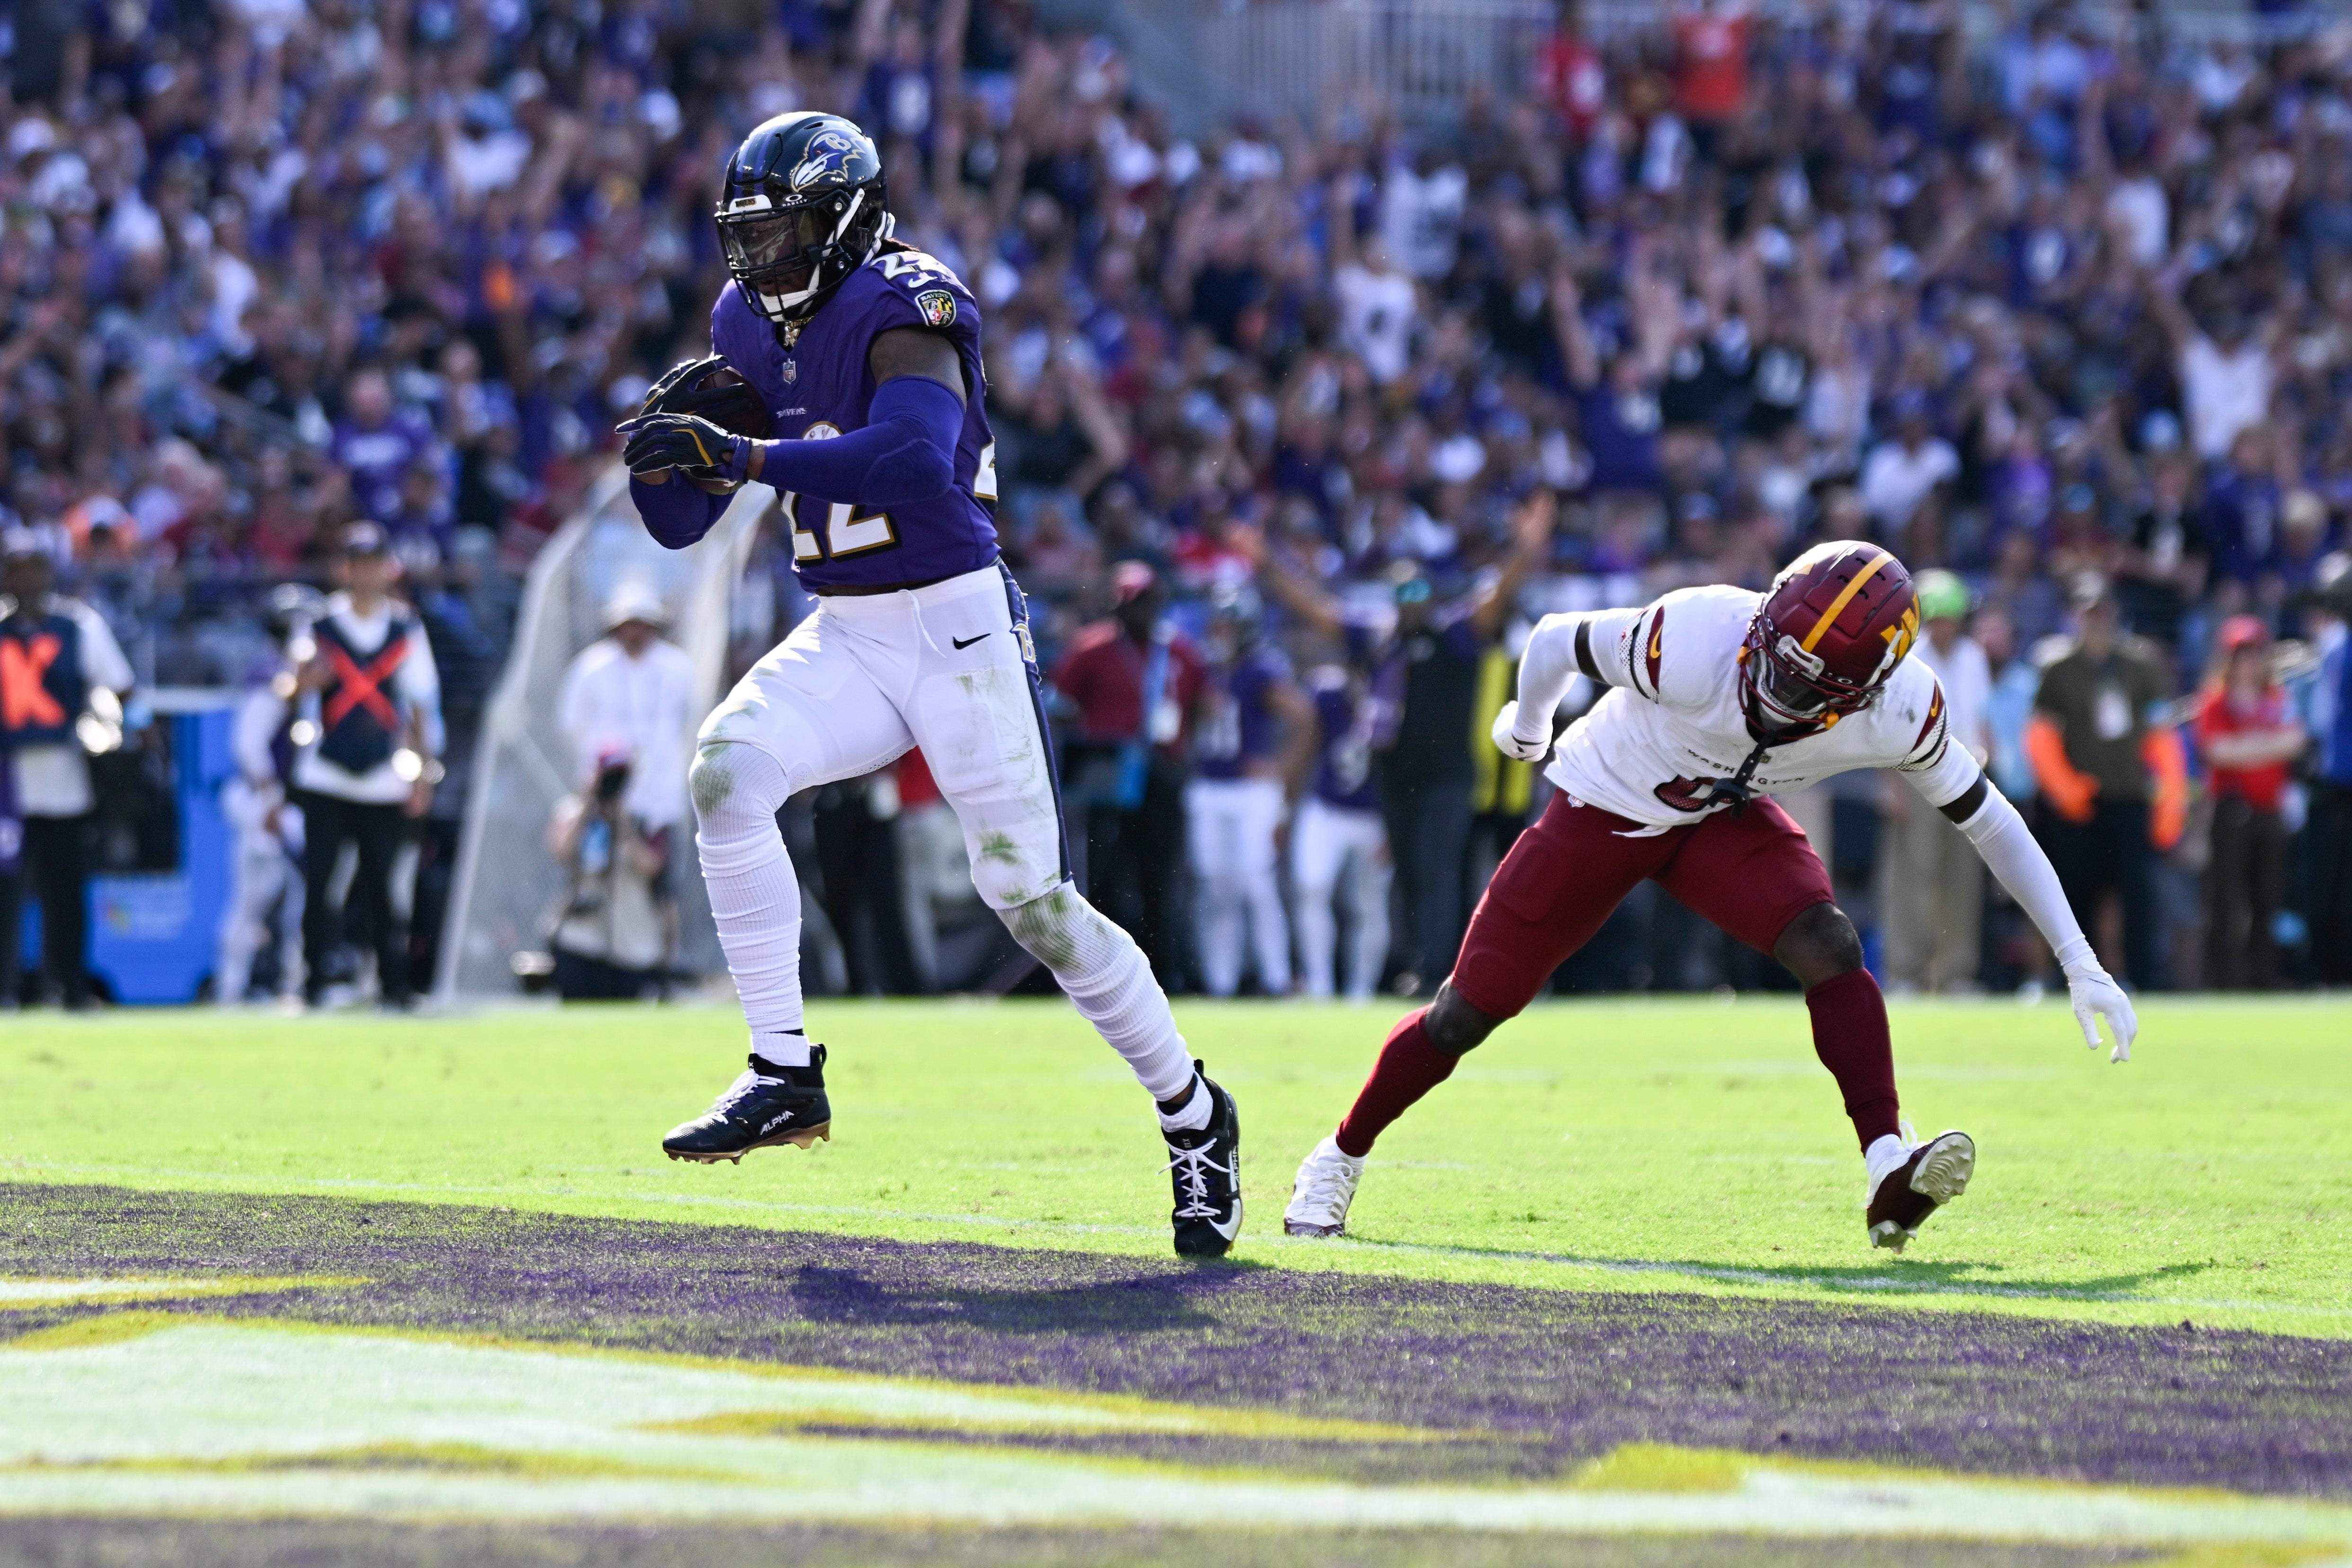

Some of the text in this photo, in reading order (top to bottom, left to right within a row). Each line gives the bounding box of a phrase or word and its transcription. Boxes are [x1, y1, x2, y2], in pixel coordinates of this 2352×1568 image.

[782, 199, 808, 207] OAKLEY
[920, 293, 949, 301] RAVENS
[777, 408, 807, 418] RAVENS
[760, 1110, 795, 1135] ALPHA
